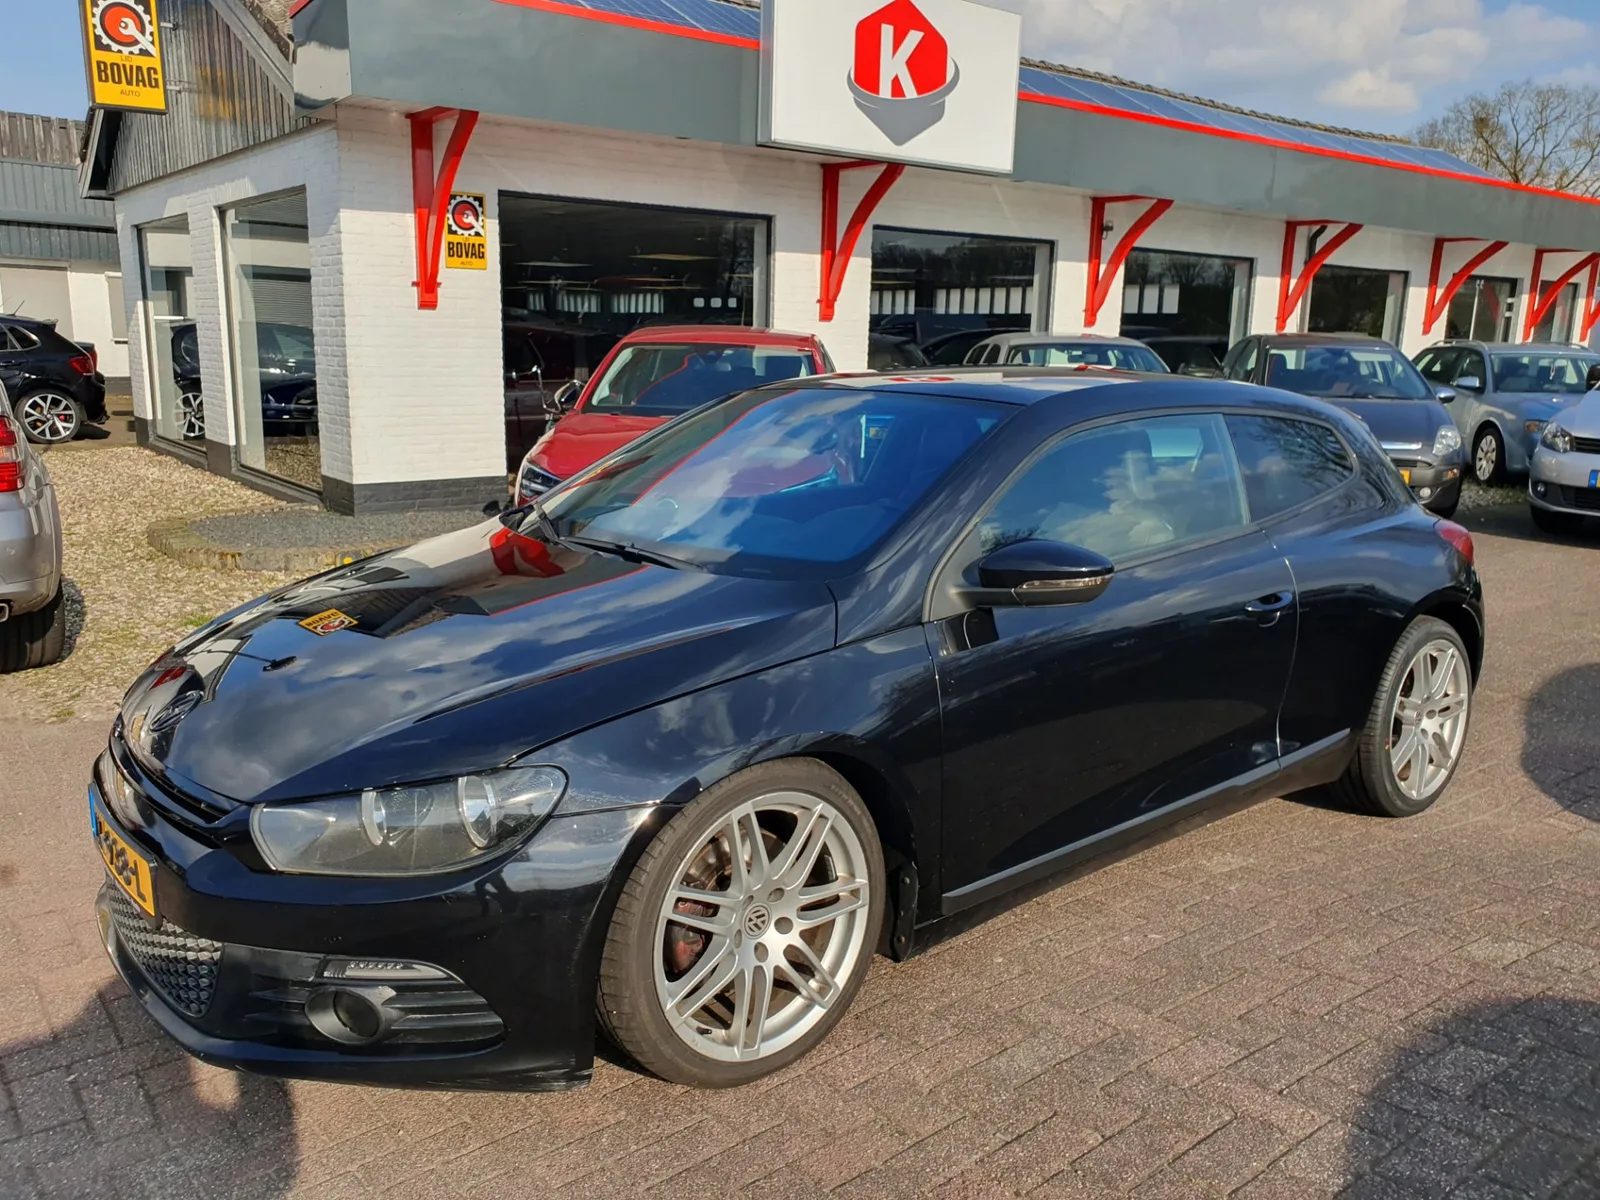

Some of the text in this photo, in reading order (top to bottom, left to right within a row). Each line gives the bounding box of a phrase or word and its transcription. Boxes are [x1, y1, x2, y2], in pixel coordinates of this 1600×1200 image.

[878, 22, 925, 98] K
[96, 60, 160, 89] BOVAG
[119, 89, 141, 97] AUTO
[447, 241, 485, 259] BOVAG
